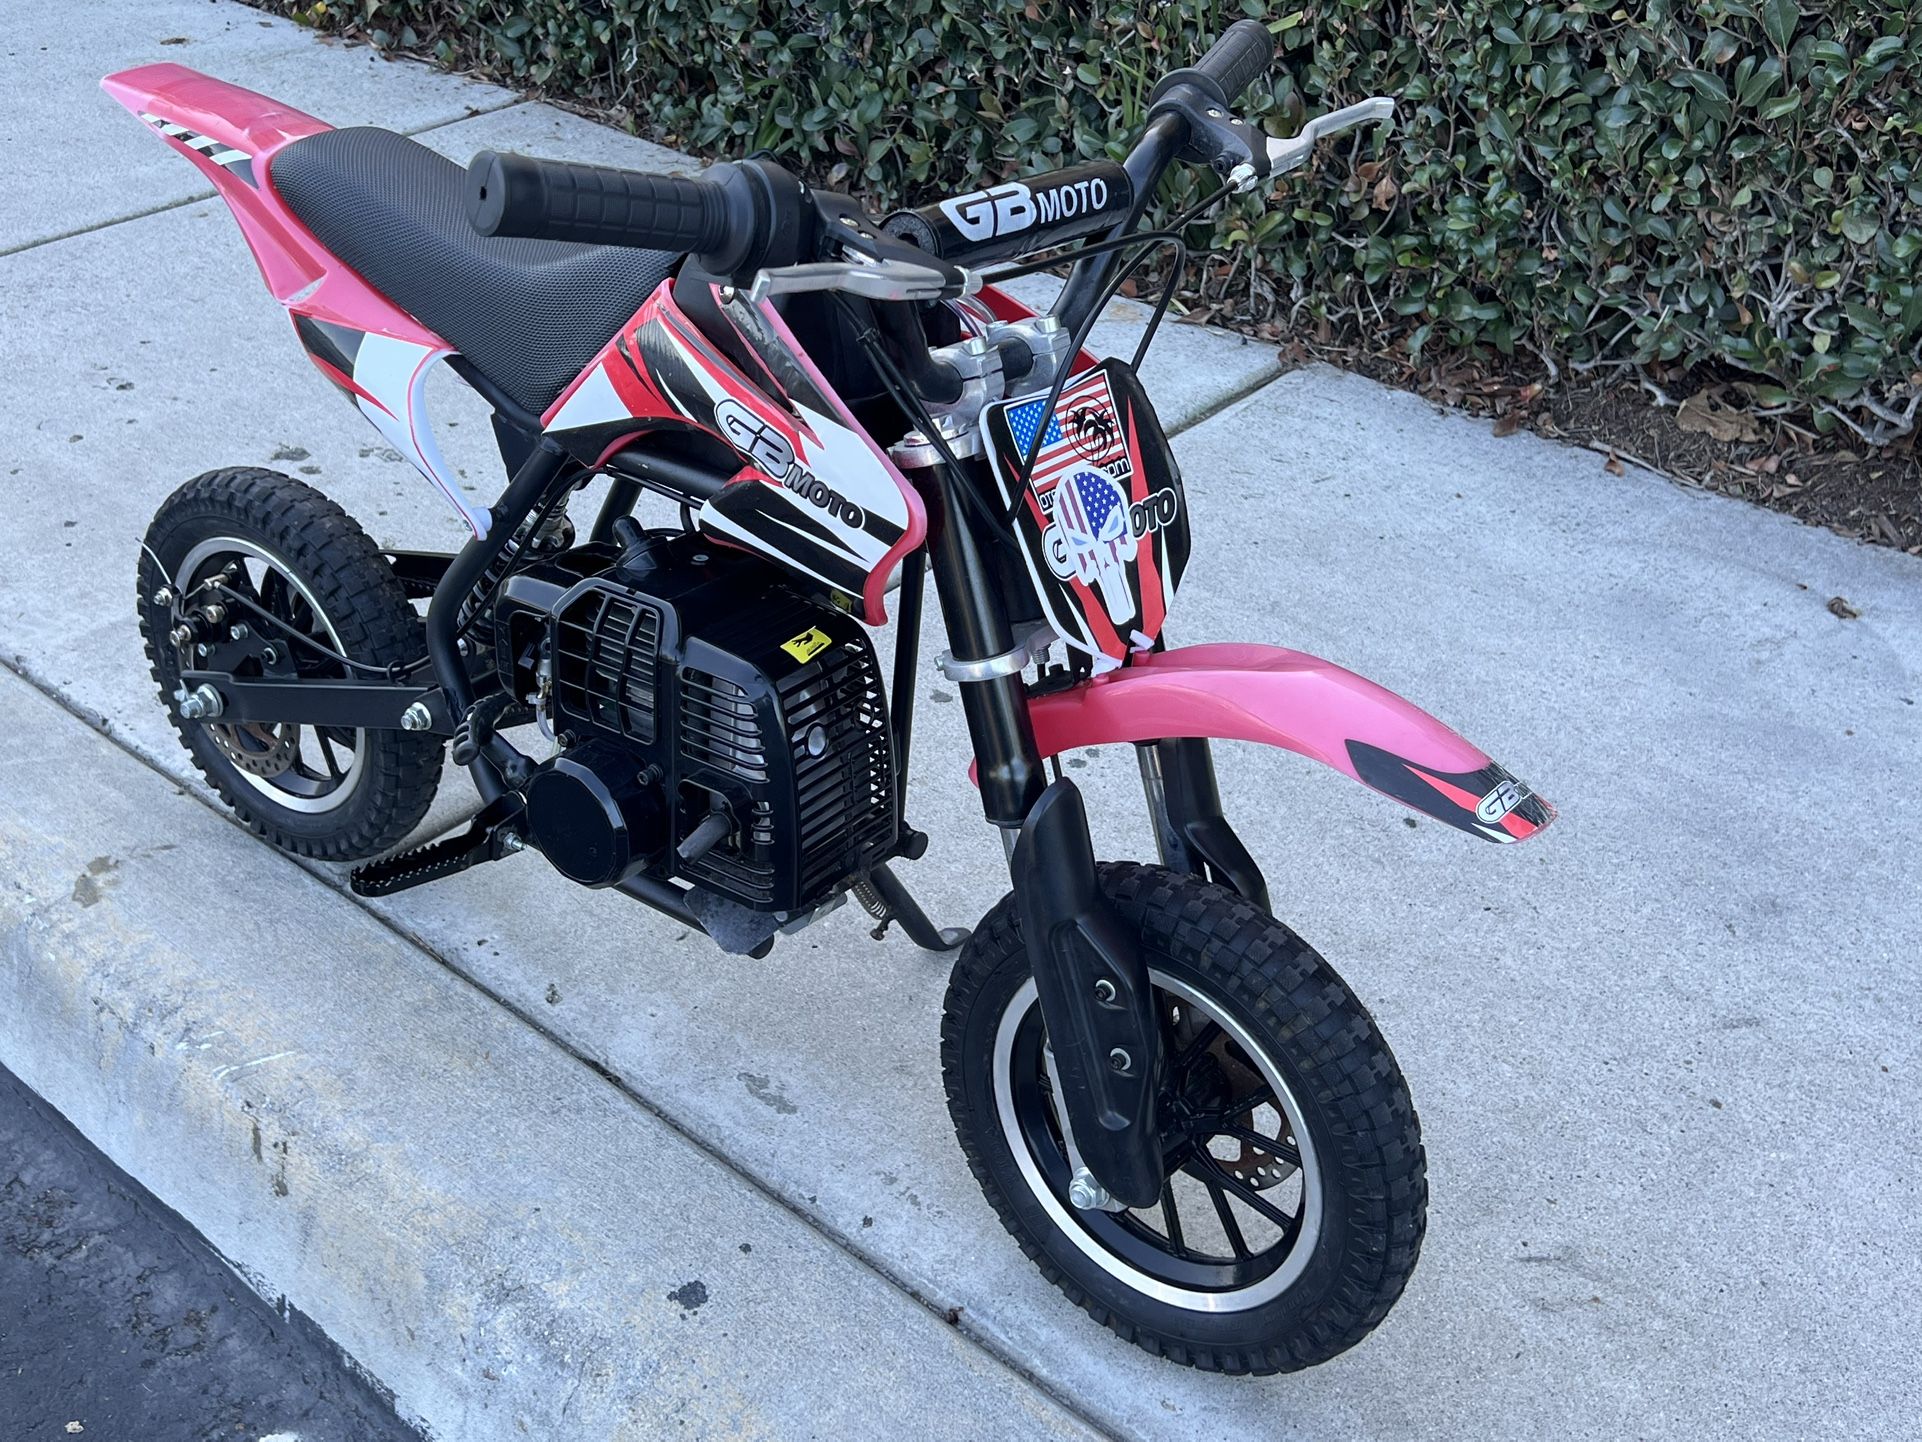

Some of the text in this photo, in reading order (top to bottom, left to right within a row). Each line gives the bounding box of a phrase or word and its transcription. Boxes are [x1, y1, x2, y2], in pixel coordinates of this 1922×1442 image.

[939, 178, 1108, 242] GB MOTO
[716, 399, 864, 528] GB MOTO
[1129, 489, 1176, 539] OTO
[1476, 781, 1521, 823] GB
